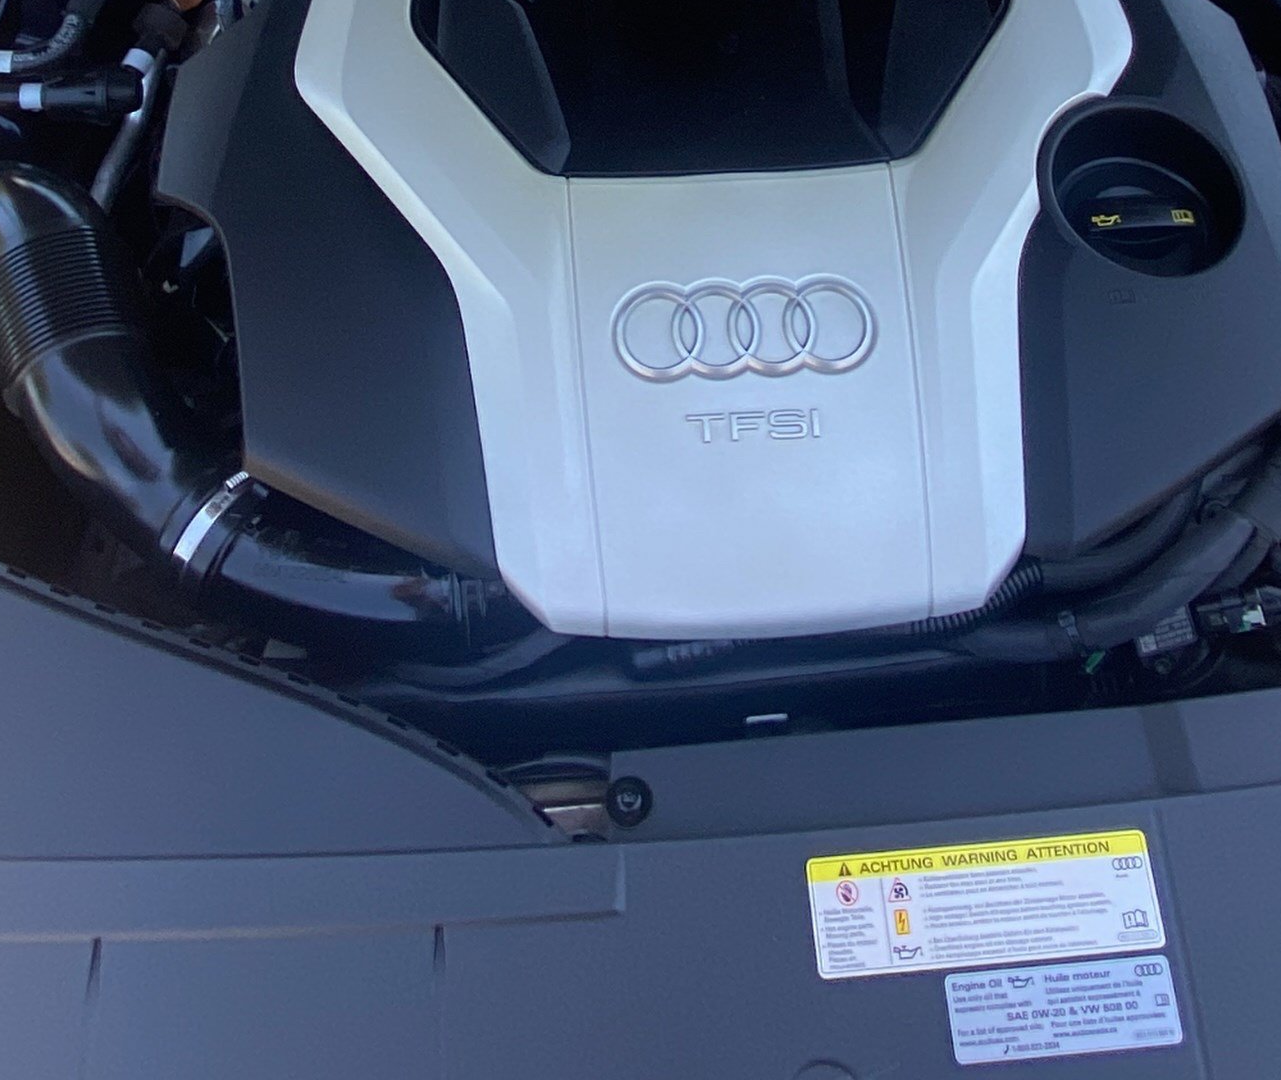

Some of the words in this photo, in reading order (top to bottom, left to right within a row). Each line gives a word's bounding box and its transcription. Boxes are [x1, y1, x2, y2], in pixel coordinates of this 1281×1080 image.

[685, 408, 821, 444] TFSI
[859, 857, 933, 874] ACHTUNG
[941, 849, 1018, 867] WARNING
[1026, 841, 1110, 860] ATTENTION
[951, 982, 986, 992] Engine
[988, 978, 1003, 988] Oil
[1044, 972, 1070, 983] Huile
[1072, 970, 1111, 980] moteur
[1006, 1011, 1029, 1022] SAE
[1031, 1007, 1066, 1020] 0W-20
[1069, 1005, 1078, 1015] &
[1081, 1003, 1100, 1014] VW
[1125, 1000, 1139, 1010] 00
